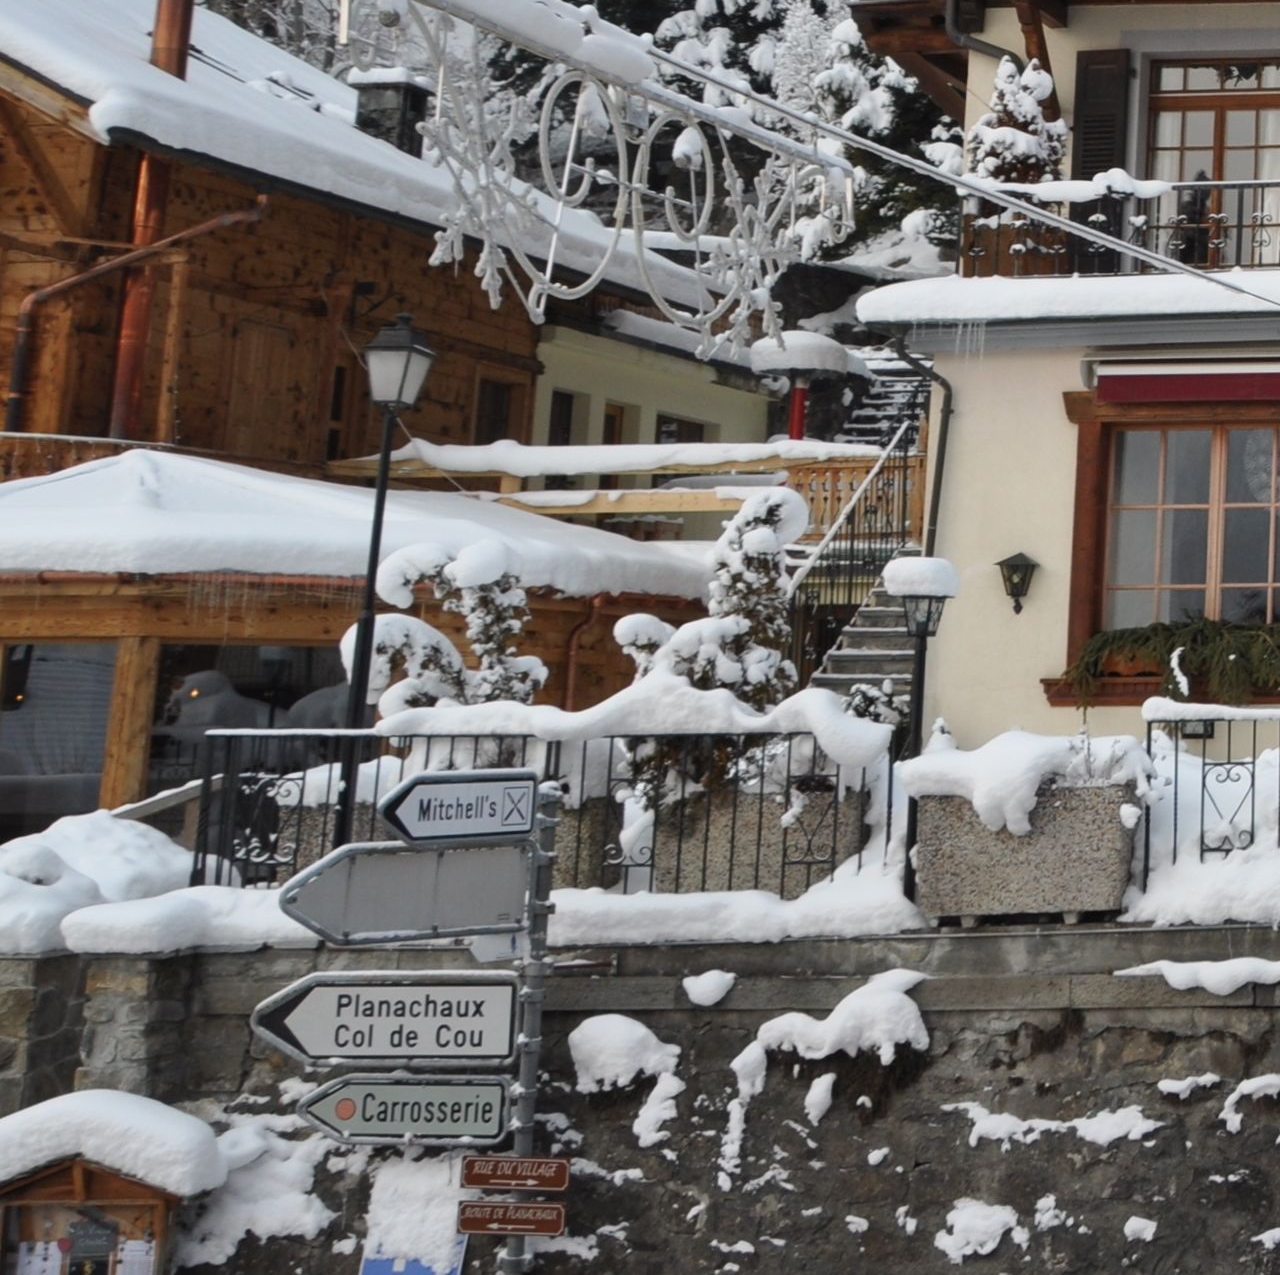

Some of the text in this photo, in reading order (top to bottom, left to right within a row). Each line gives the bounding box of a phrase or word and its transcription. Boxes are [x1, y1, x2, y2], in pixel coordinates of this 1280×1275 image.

[417, 795, 498, 823] Mitchell's
[335, 994, 485, 1019] Planachaux
[334, 1025, 484, 1048] Col de Cou
[361, 1091, 494, 1124] Carrosserie
[472, 1161, 559, 1177] RUE DU VILLAGE
[464, 1206, 492, 1218] ROUTE
[493, 1207, 505, 1218] DE
